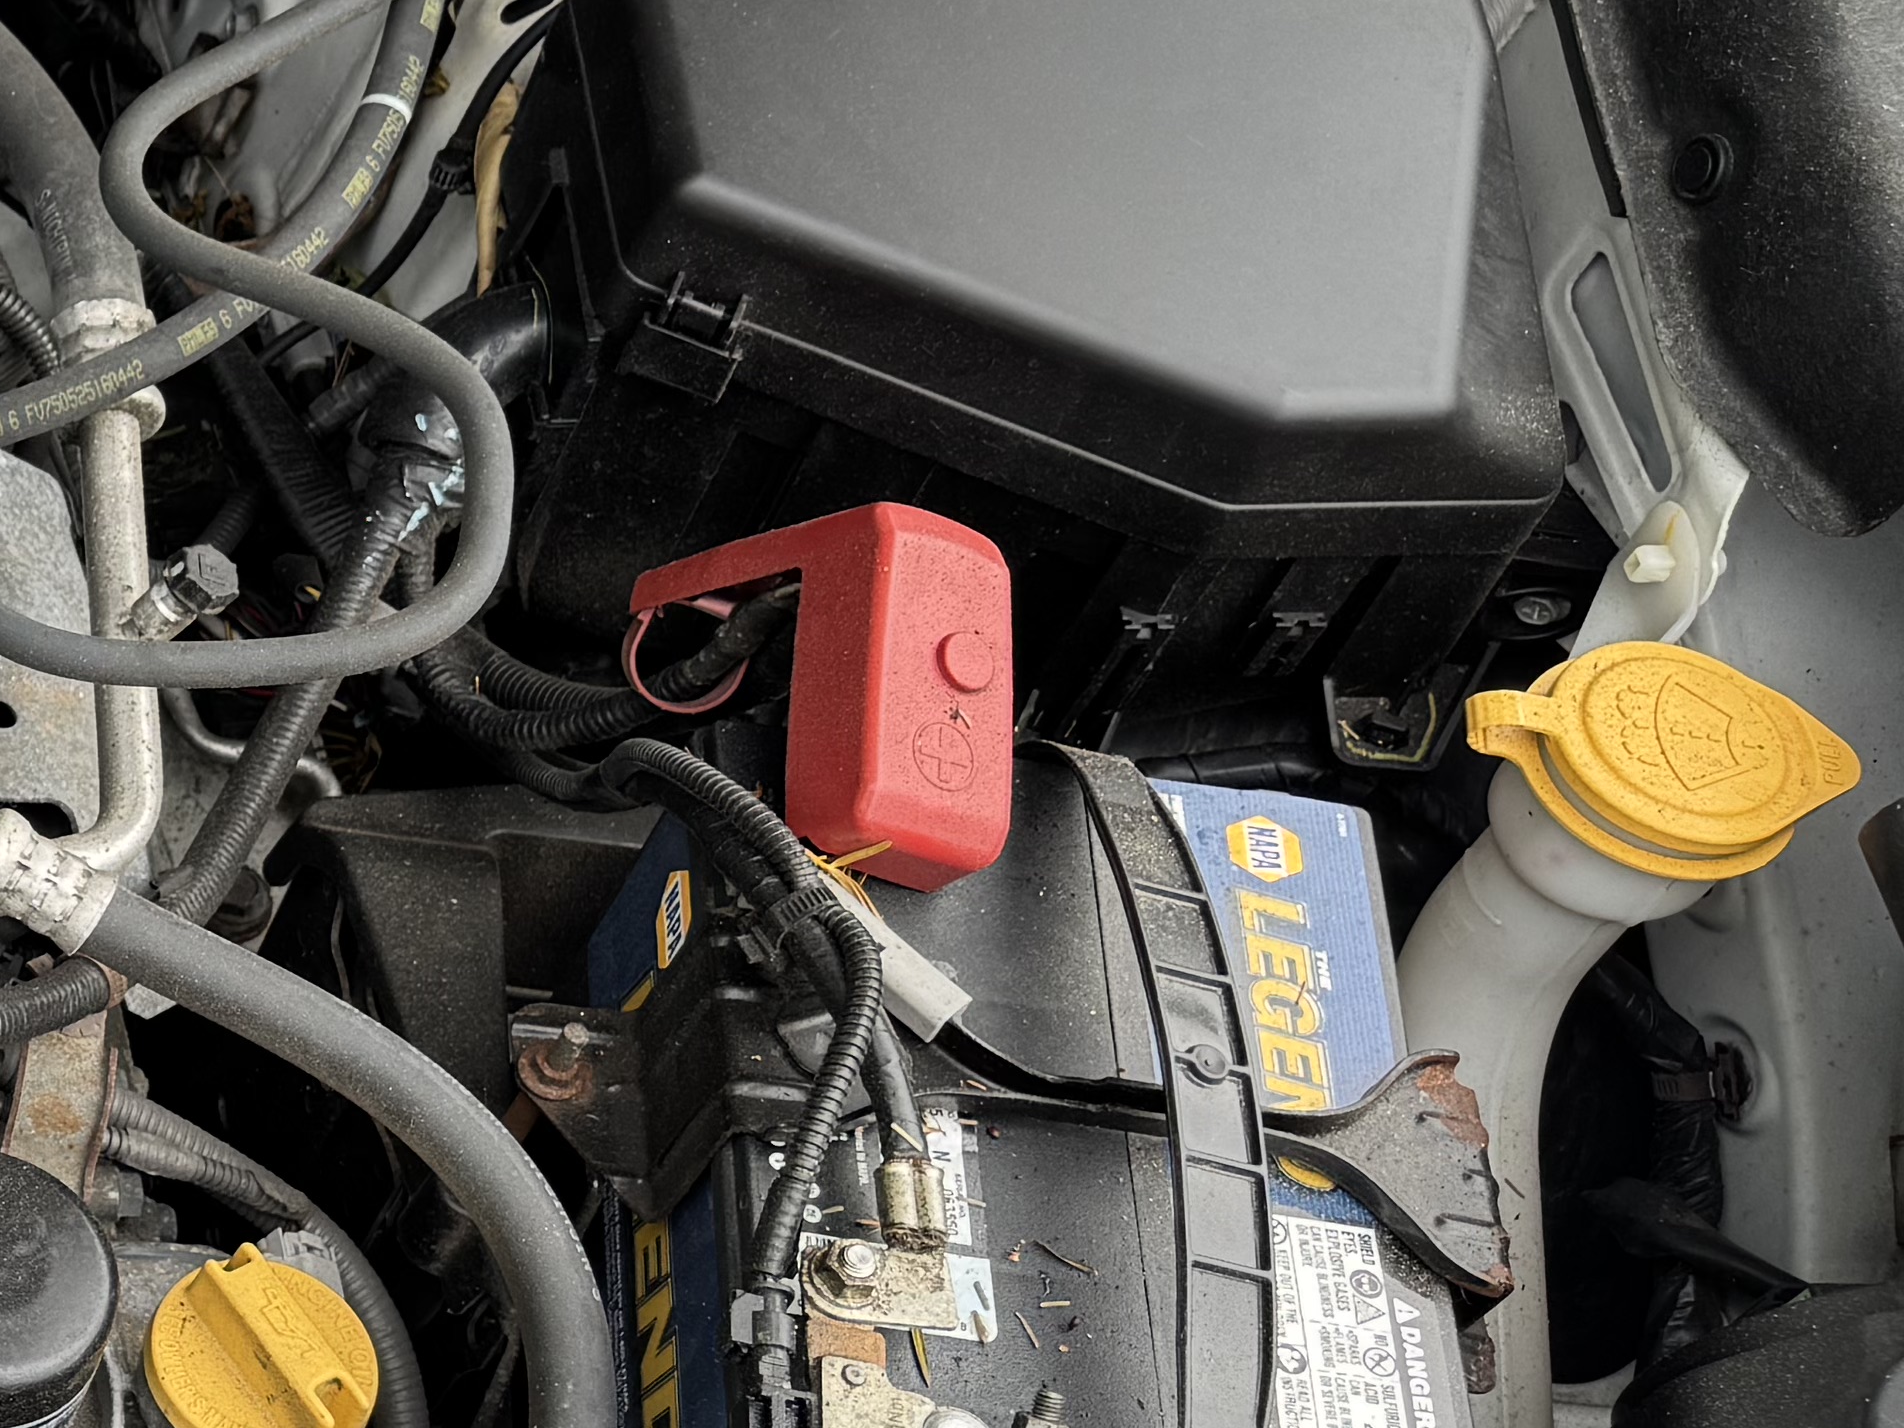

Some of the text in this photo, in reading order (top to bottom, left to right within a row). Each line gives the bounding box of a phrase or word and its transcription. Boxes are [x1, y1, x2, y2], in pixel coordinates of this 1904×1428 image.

[219, 309, 233, 330] 6
[7, 409, 21, 431] 6
[1247, 825, 1283, 870] NAPA
[664, 880, 683, 961] NAPA
[1314, 949, 1333, 992] THE
[1234, 888, 1334, 1112] LEGEN
[1341, 1231, 1358, 1257] EYES.
[1357, 1233, 1375, 1266] SHIELD
[1325, 1228, 1351, 1312] EXPLOSIVE GASES
[1364, 1380, 1380, 1405] ACID
[1299, 1405, 1313, 1421] ALL
